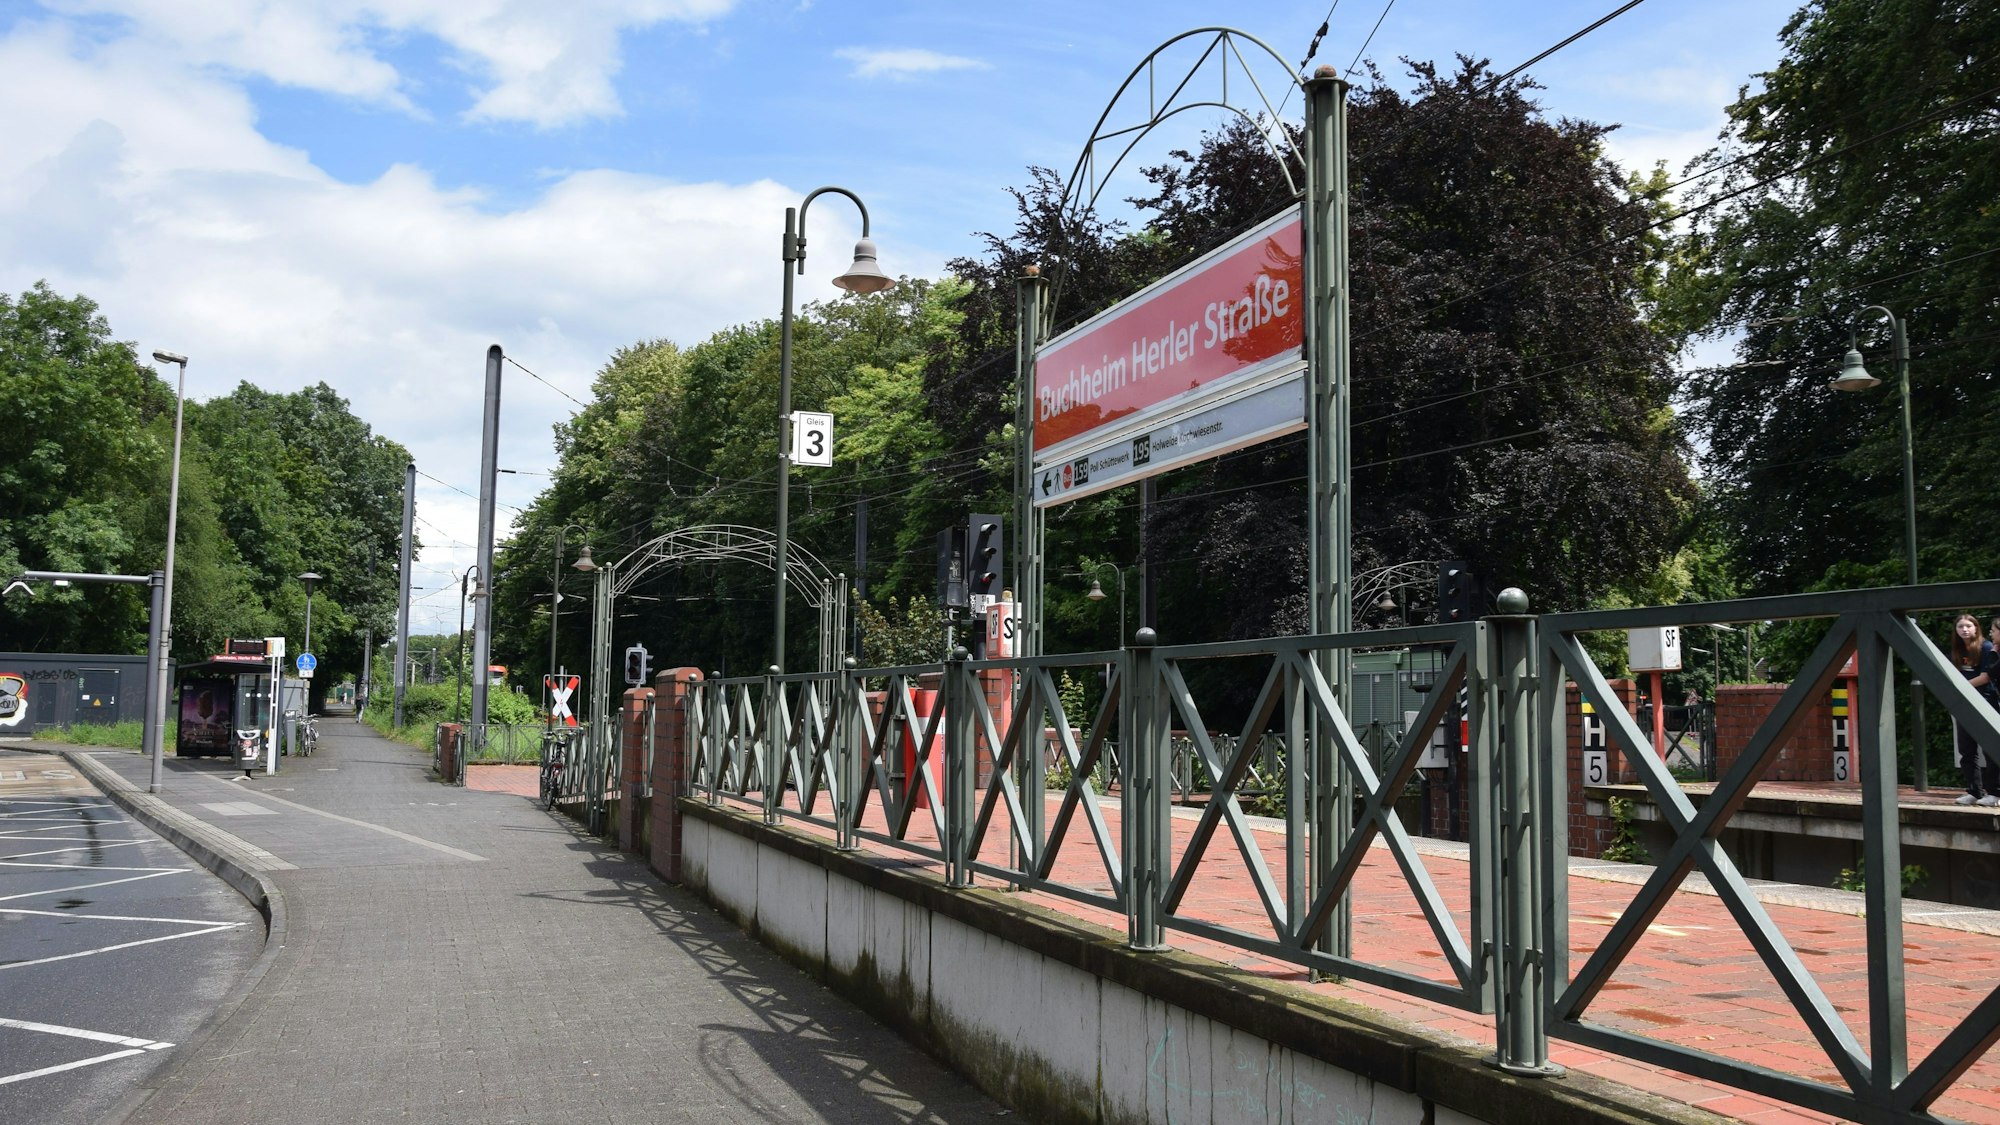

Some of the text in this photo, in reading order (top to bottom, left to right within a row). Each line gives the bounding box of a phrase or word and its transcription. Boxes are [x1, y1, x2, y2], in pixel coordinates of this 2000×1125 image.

[1040, 273, 1290, 422] Buchheim Herler Straße
[806, 417, 825, 426] Gleis
[806, 429, 825, 457] 3
[1074, 462, 1088, 482] 159
[1090, 459, 1099, 472] Poll
[1099, 452, 1130, 470] Schüttewerk
[1133, 440, 1150, 461] 195
[1152, 436, 1178, 452] Holweide
[1665, 629, 1676, 648] SF
[1583, 716, 1606, 747] H
[1832, 719, 1849, 748] H
[1589, 756, 1602, 783] 5
[1836, 756, 1848, 781] 3
